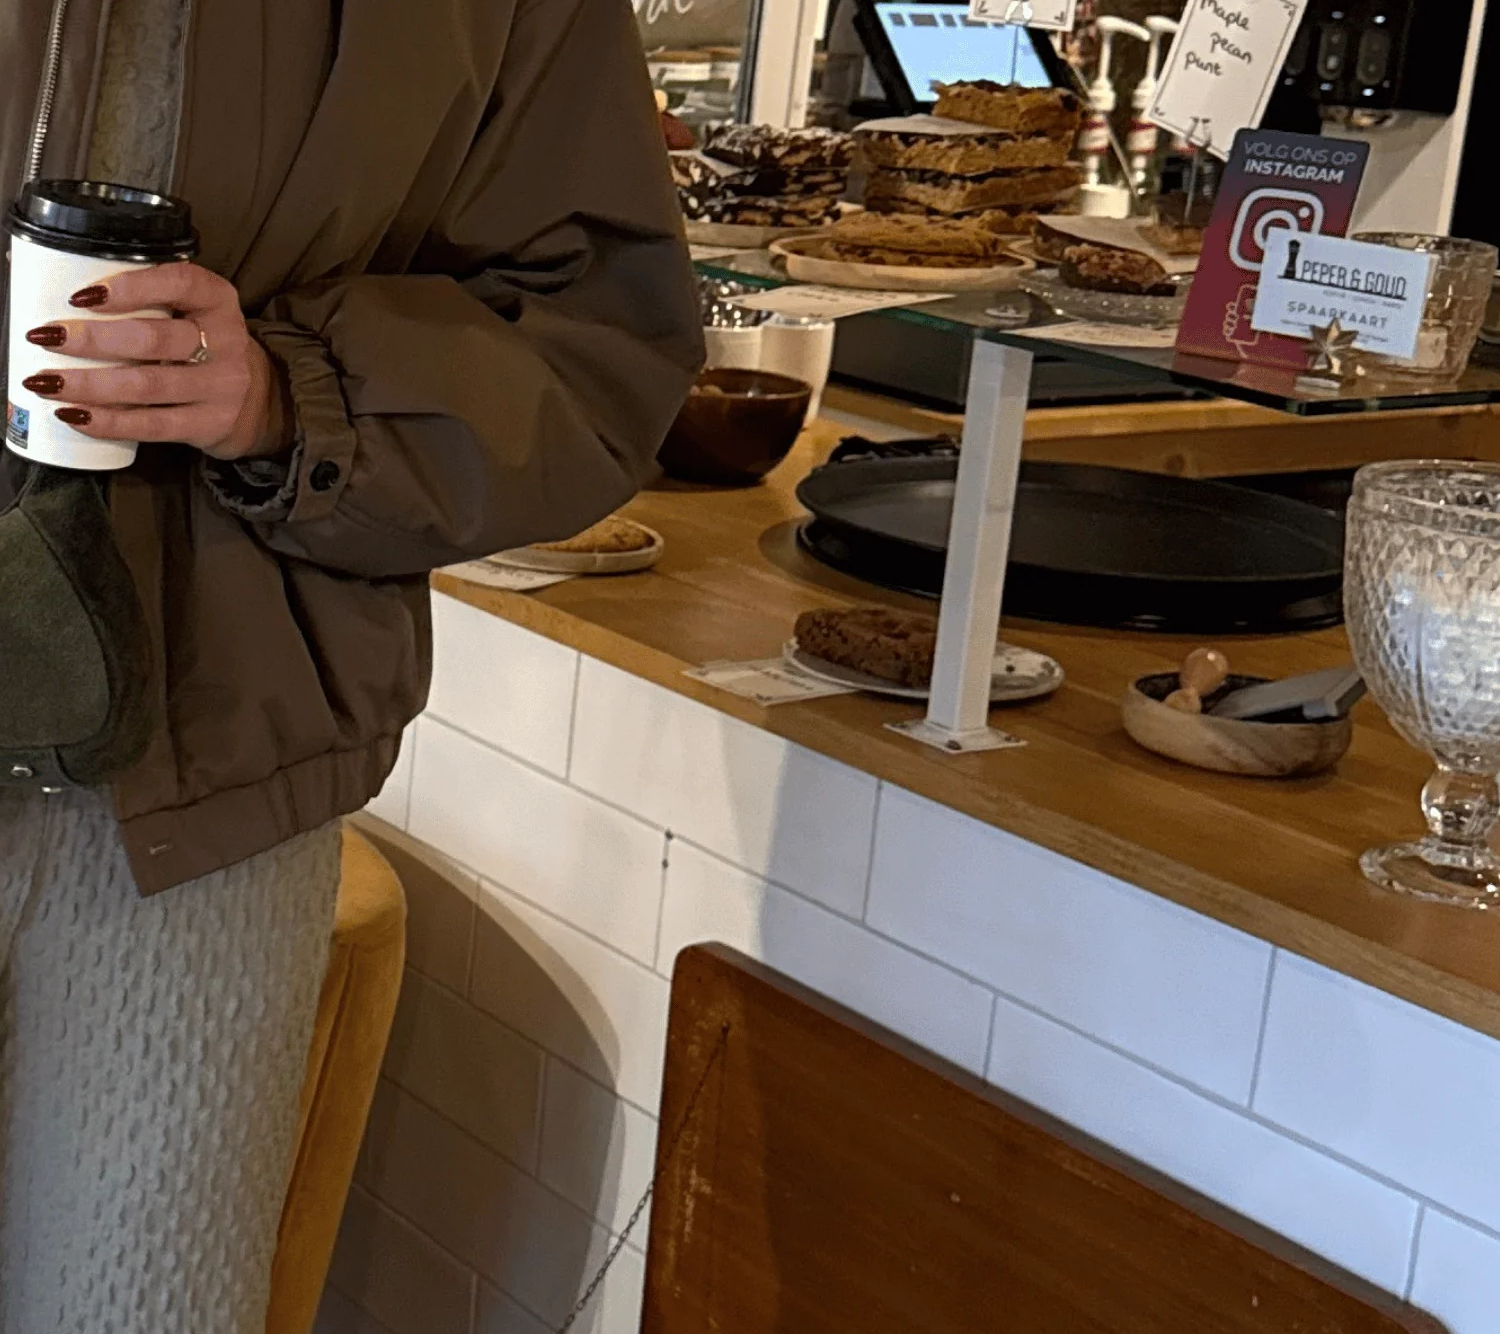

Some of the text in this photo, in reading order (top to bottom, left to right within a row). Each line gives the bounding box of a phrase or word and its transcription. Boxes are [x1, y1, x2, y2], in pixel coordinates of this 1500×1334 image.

[1184, 51, 1222, 77] punt
[1244, 141, 1357, 165] VOLG ONS OP
[1244, 160, 1344, 183] INSTAGRAM
[1301, 260, 1407, 297] PEPER & GOUD
[1286, 300, 1389, 329] SPAARKAART
